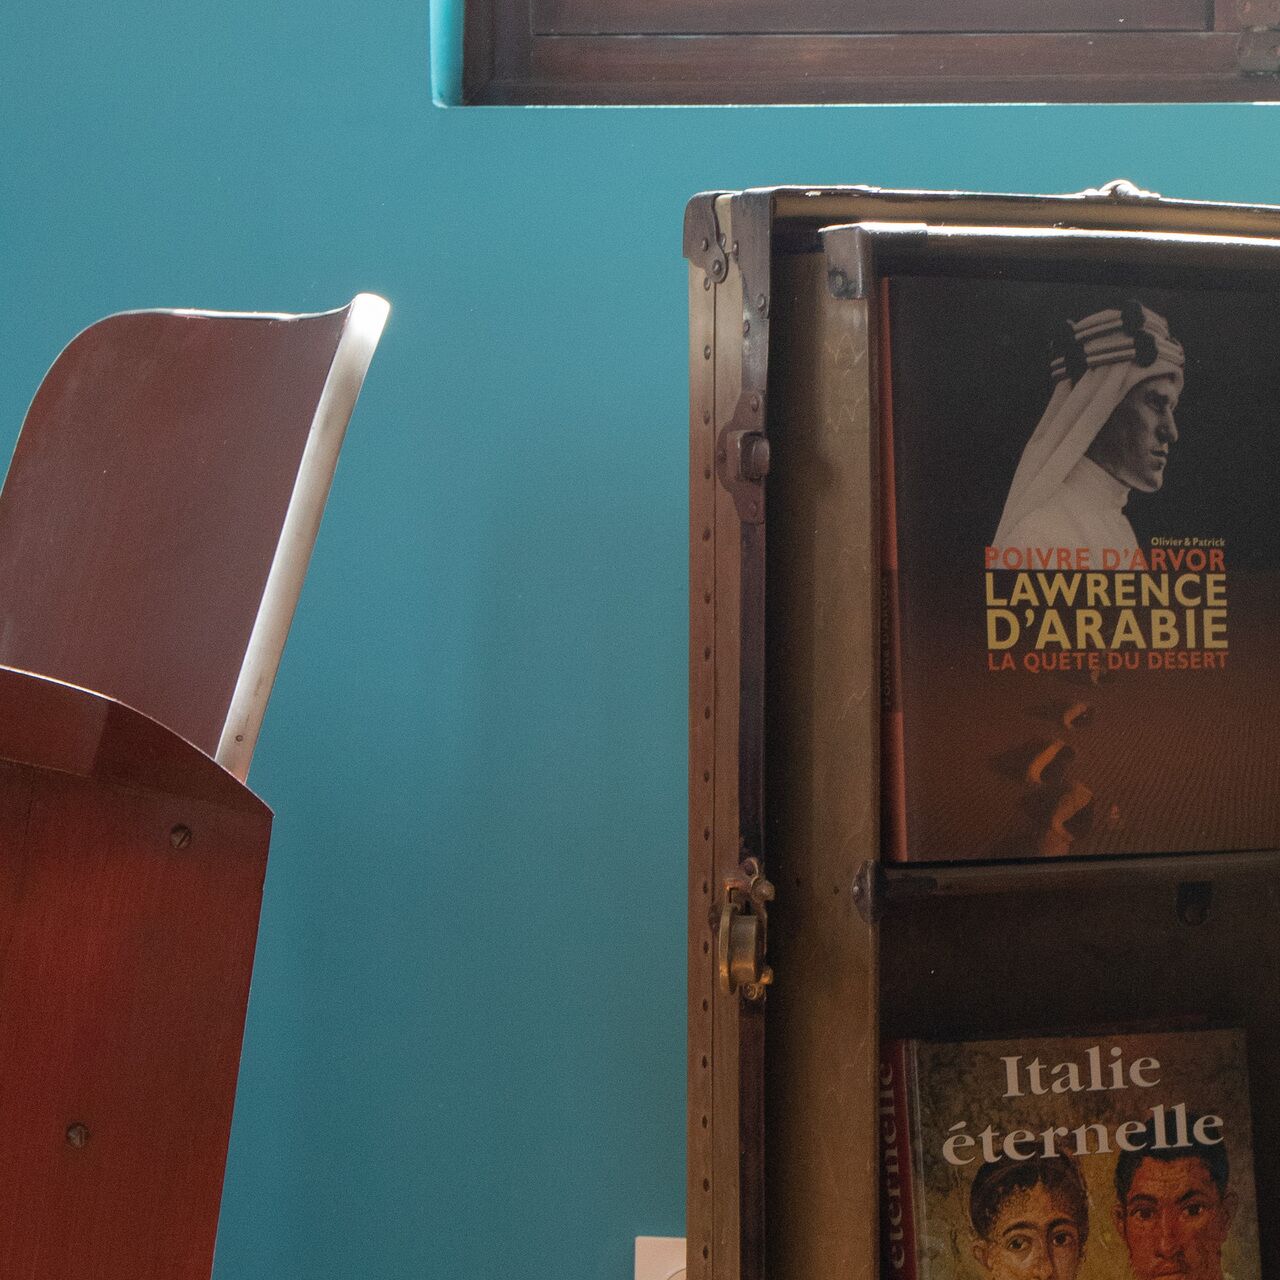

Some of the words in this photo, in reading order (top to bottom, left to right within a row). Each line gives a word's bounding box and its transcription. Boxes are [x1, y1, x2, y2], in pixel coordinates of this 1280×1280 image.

[984, 546, 1089, 570] POIVRE
[1102, 547, 1226, 571] D'ARVOR
[1151, 536, 1183, 546] Olivier
[1184, 537, 1191, 546] &
[1193, 537, 1225, 546] Patrick
[985, 572, 1228, 607] LAWRENCE
[986, 608, 1229, 650] D'ARABIE
[987, 652, 1016, 670] LA
[1107, 651, 1141, 670] DU
[1000, 1045, 1161, 1098] Italie
[942, 1102, 1225, 1166] éternelle
